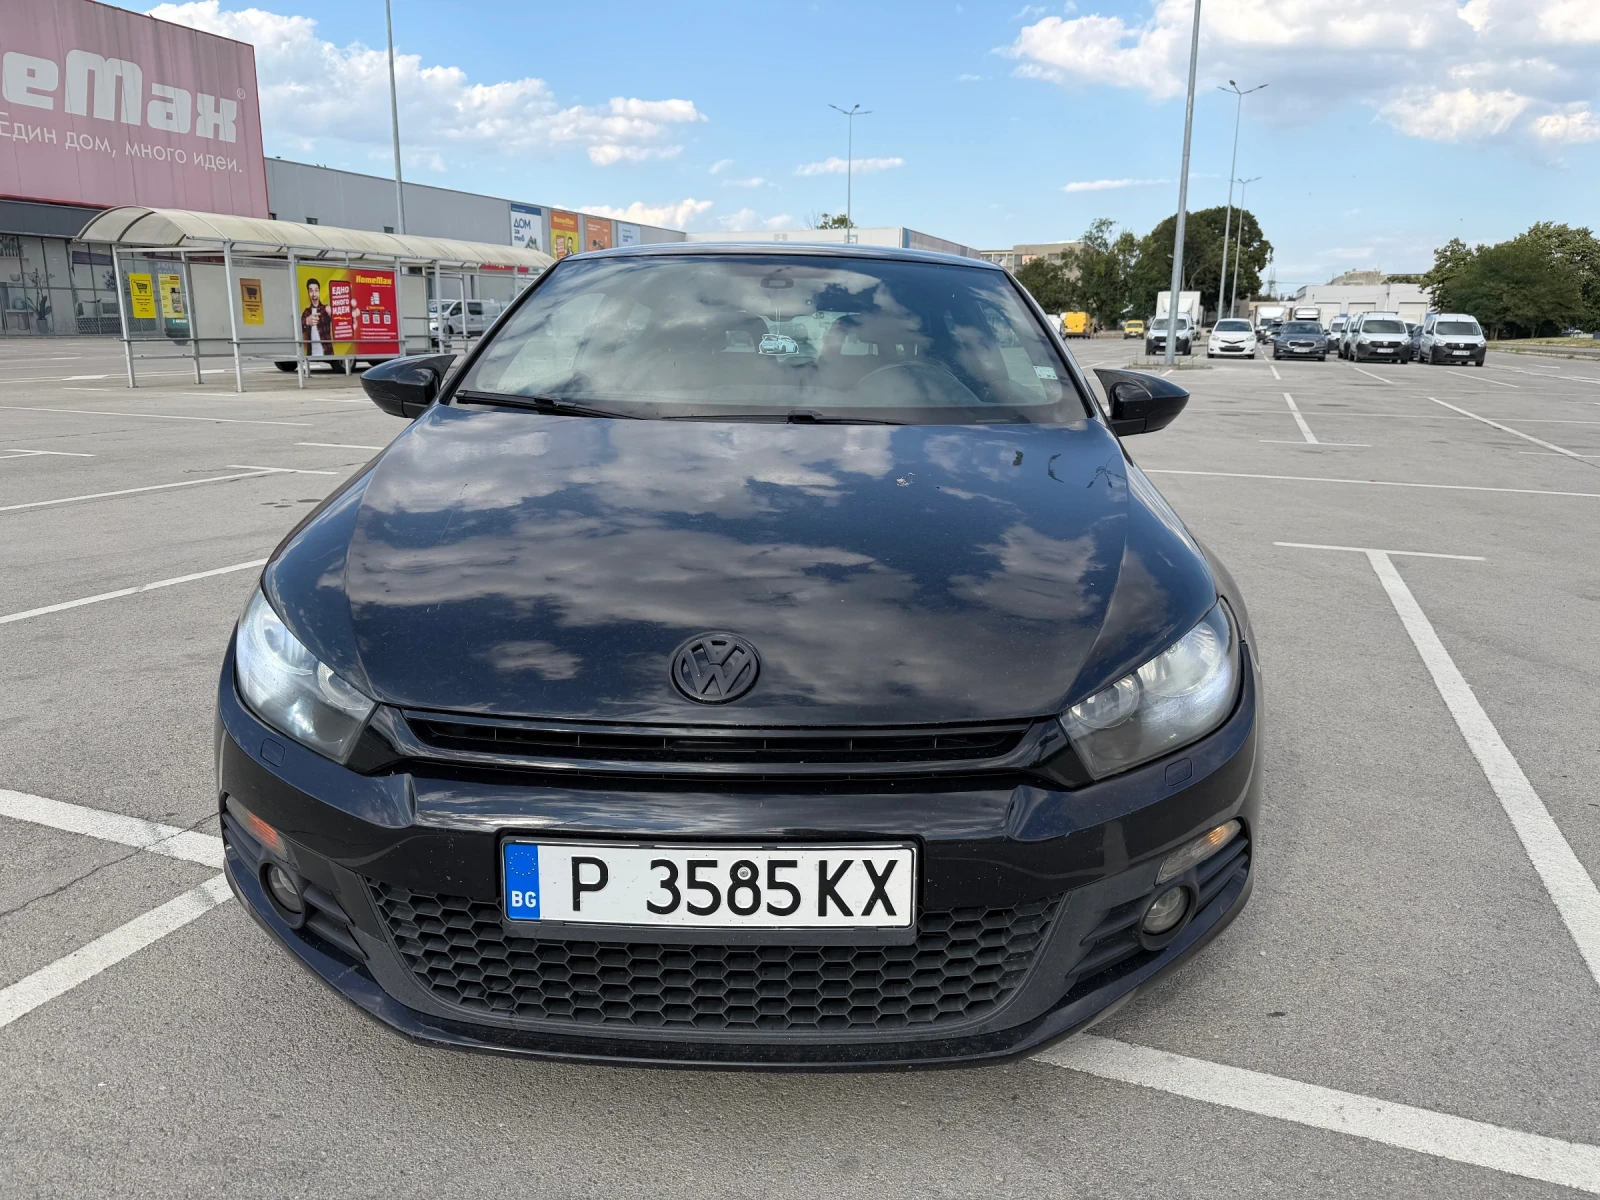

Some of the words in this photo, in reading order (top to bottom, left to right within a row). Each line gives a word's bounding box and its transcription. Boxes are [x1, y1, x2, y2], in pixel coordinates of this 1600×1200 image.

[2, 49, 238, 143] eMax
[0, 111, 57, 145] Един
[65, 131, 117, 158] дом,
[125, 141, 187, 164] много
[193, 151, 243, 173] идеи.
[513, 217, 532, 230] ДОМ
[355, 275, 392, 285] HomeMax
[332, 286, 350, 295] ЕДНО
[332, 298, 350, 306] МНОГО
[332, 306, 350, 315] ИДЕИ
[571, 856, 609, 912] P
[511, 890, 537, 908] BG
